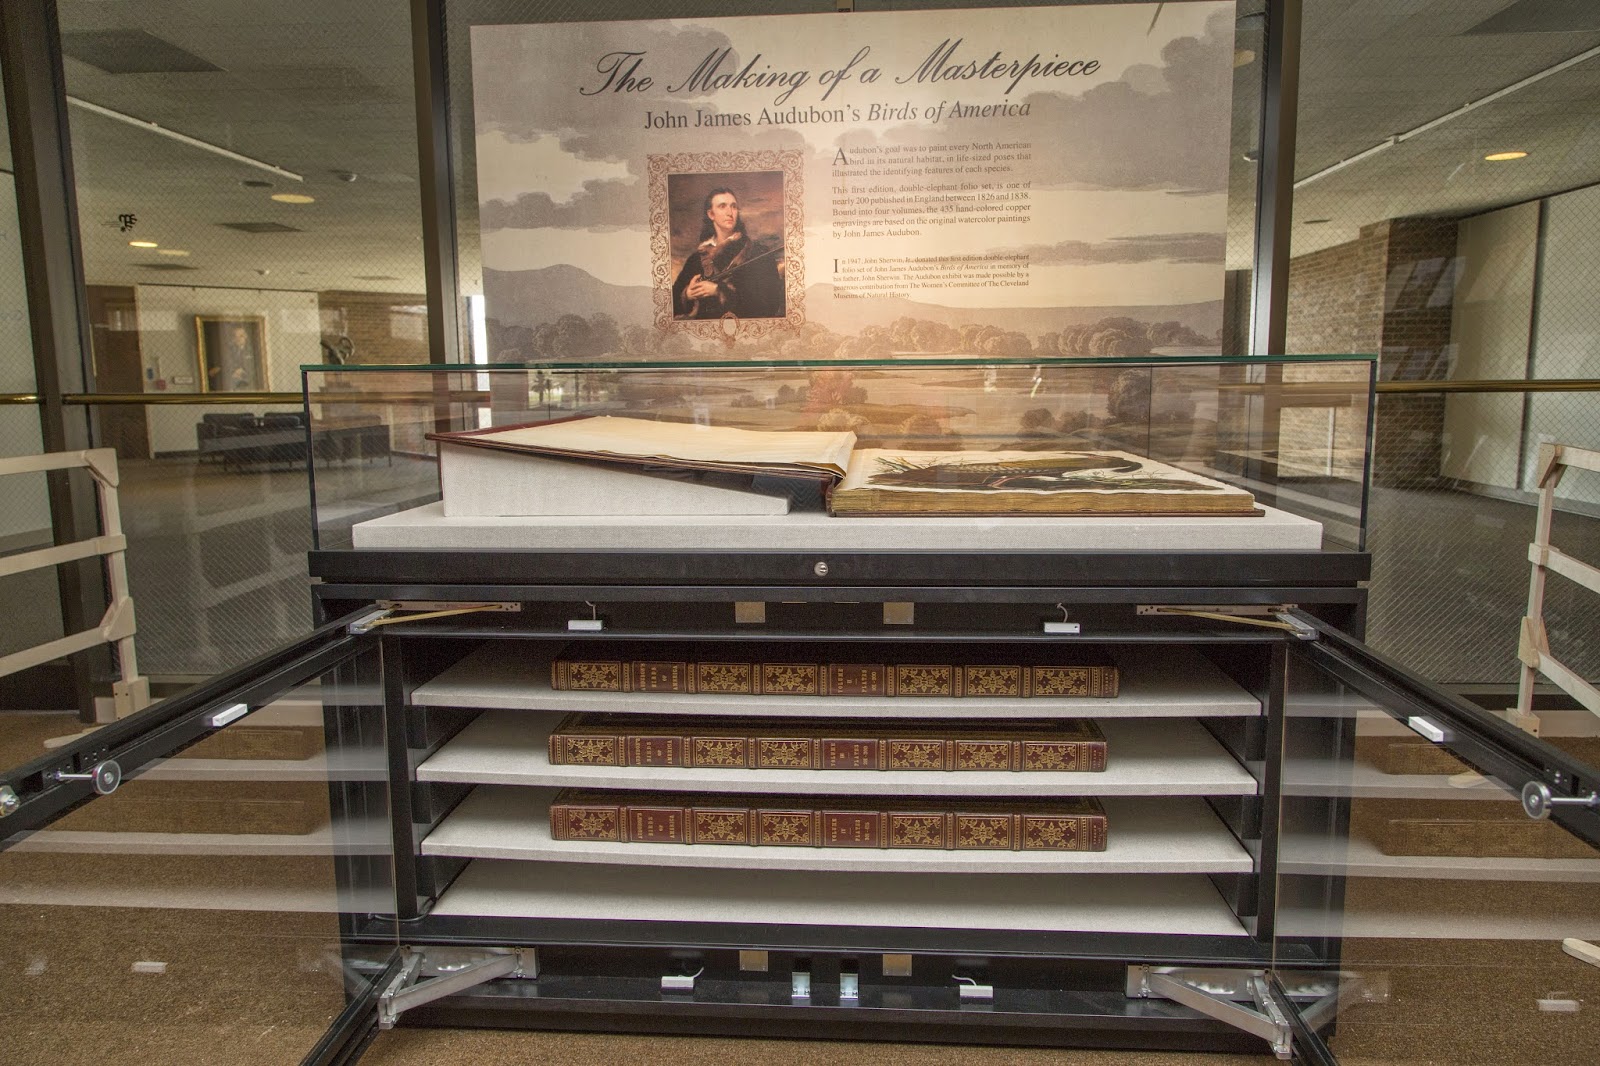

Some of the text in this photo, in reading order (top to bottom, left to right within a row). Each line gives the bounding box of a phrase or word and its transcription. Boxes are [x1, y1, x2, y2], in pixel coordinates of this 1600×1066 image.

[579, 38, 1101, 106] The Making of a Masterpiece
[644, 99, 1031, 128] John James Audubon's Birds of America
[885, 146, 900, 154] goal
[929, 144, 947, 153] paint
[949, 144, 970, 152] every
[994, 153, 1014, 162] poses
[832, 169, 867, 177] illustrated
[883, 168, 922, 176] identifying
[925, 166, 953, 174] features
[833, 198, 854, 206] nearly
[871, 196, 905, 205] published
[914, 194, 944, 204] England
[956, 204, 1003, 212] hand-colored
[1006, 204, 1031, 212] copper
[833, 219, 870, 228] engravings
[929, 217, 956, 225] original
[997, 216, 1030, 224] paintings
